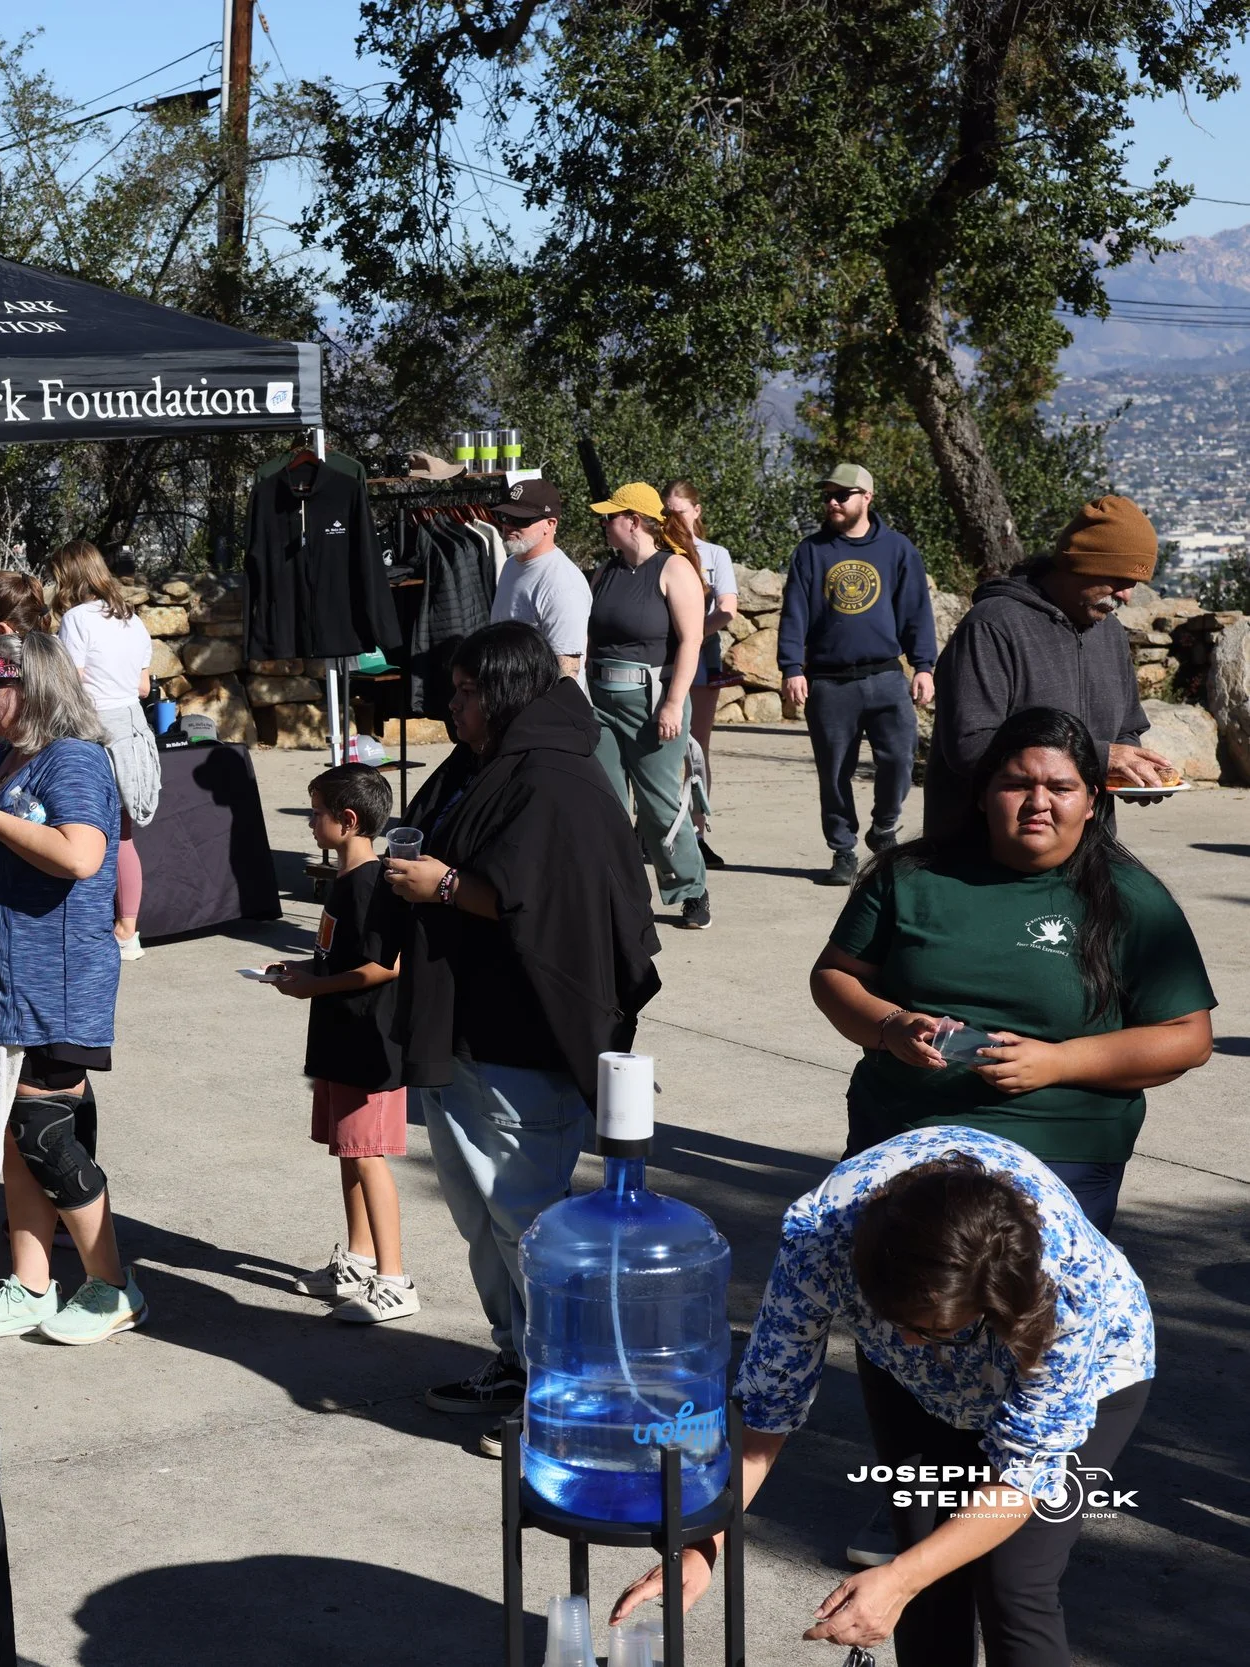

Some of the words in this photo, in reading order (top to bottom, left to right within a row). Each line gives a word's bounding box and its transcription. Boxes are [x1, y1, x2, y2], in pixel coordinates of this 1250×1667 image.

[38, 375, 261, 421] Foundation
[830, 564, 851, 582] UNITED
[852, 564, 875, 580] STATES
